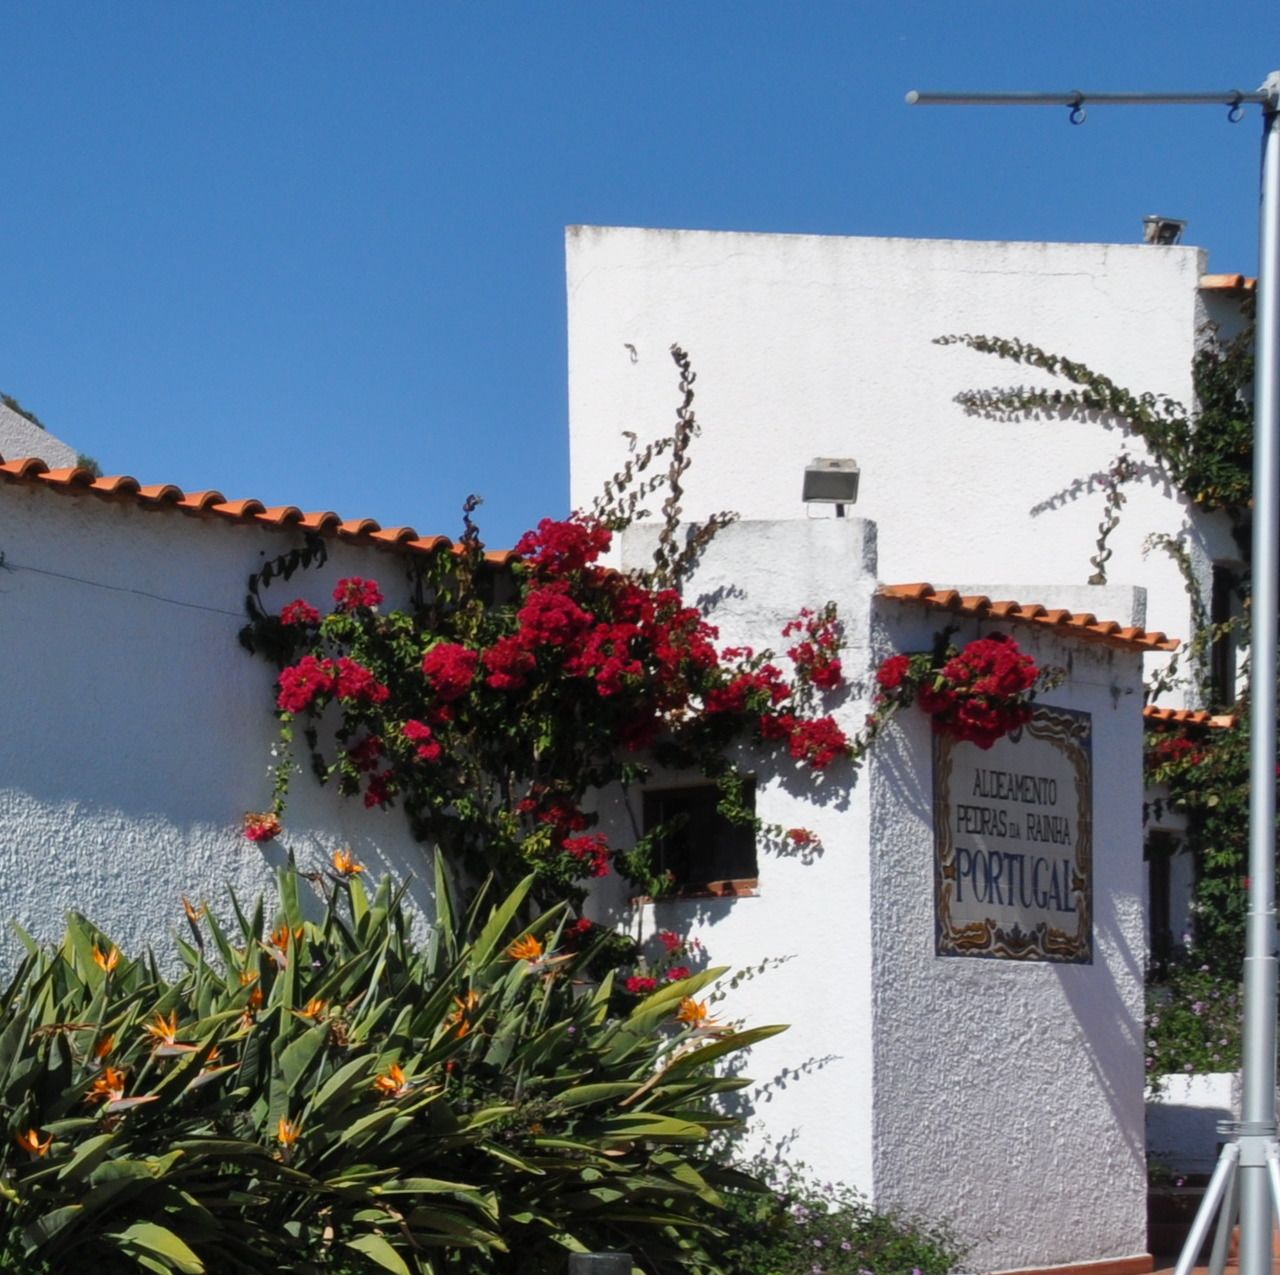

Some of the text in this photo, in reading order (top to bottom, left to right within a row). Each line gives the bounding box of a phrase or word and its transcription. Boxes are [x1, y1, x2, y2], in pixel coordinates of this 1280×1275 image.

[972, 768, 1057, 806] ALDEAMENTO
[956, 804, 1007, 838] PEDRAS
[1026, 813, 1071, 846] RAINHA
[954, 847, 1076, 912] PORTUGAL
